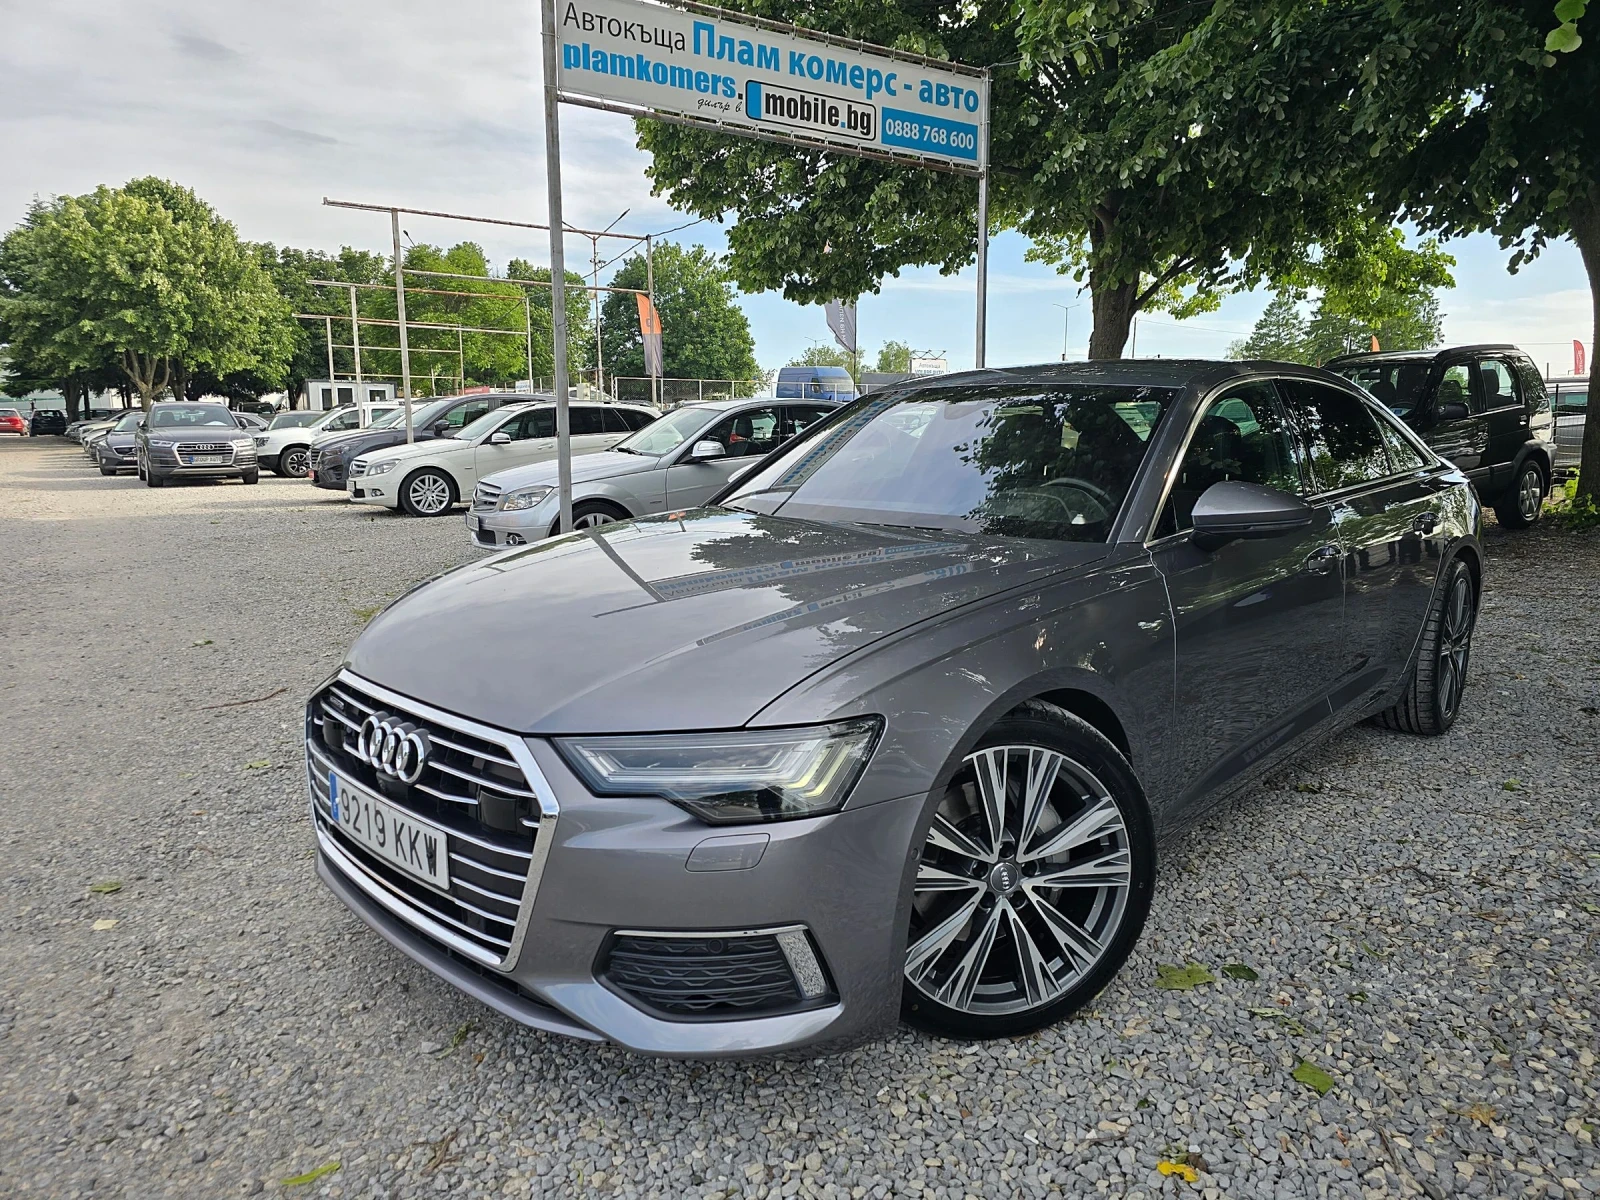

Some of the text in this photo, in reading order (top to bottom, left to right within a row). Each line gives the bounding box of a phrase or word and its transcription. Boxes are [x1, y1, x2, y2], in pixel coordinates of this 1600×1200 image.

[563, 2, 686, 54] Автокъща
[693, 20, 780, 72] Плам
[789, 50, 897, 100] комерс
[918, 79, 979, 113] авто
[765, 92, 872, 136] mobile.bg
[885, 118, 974, 150] 0888 768 600
[341, 788, 437, 877] 9219 KKW
